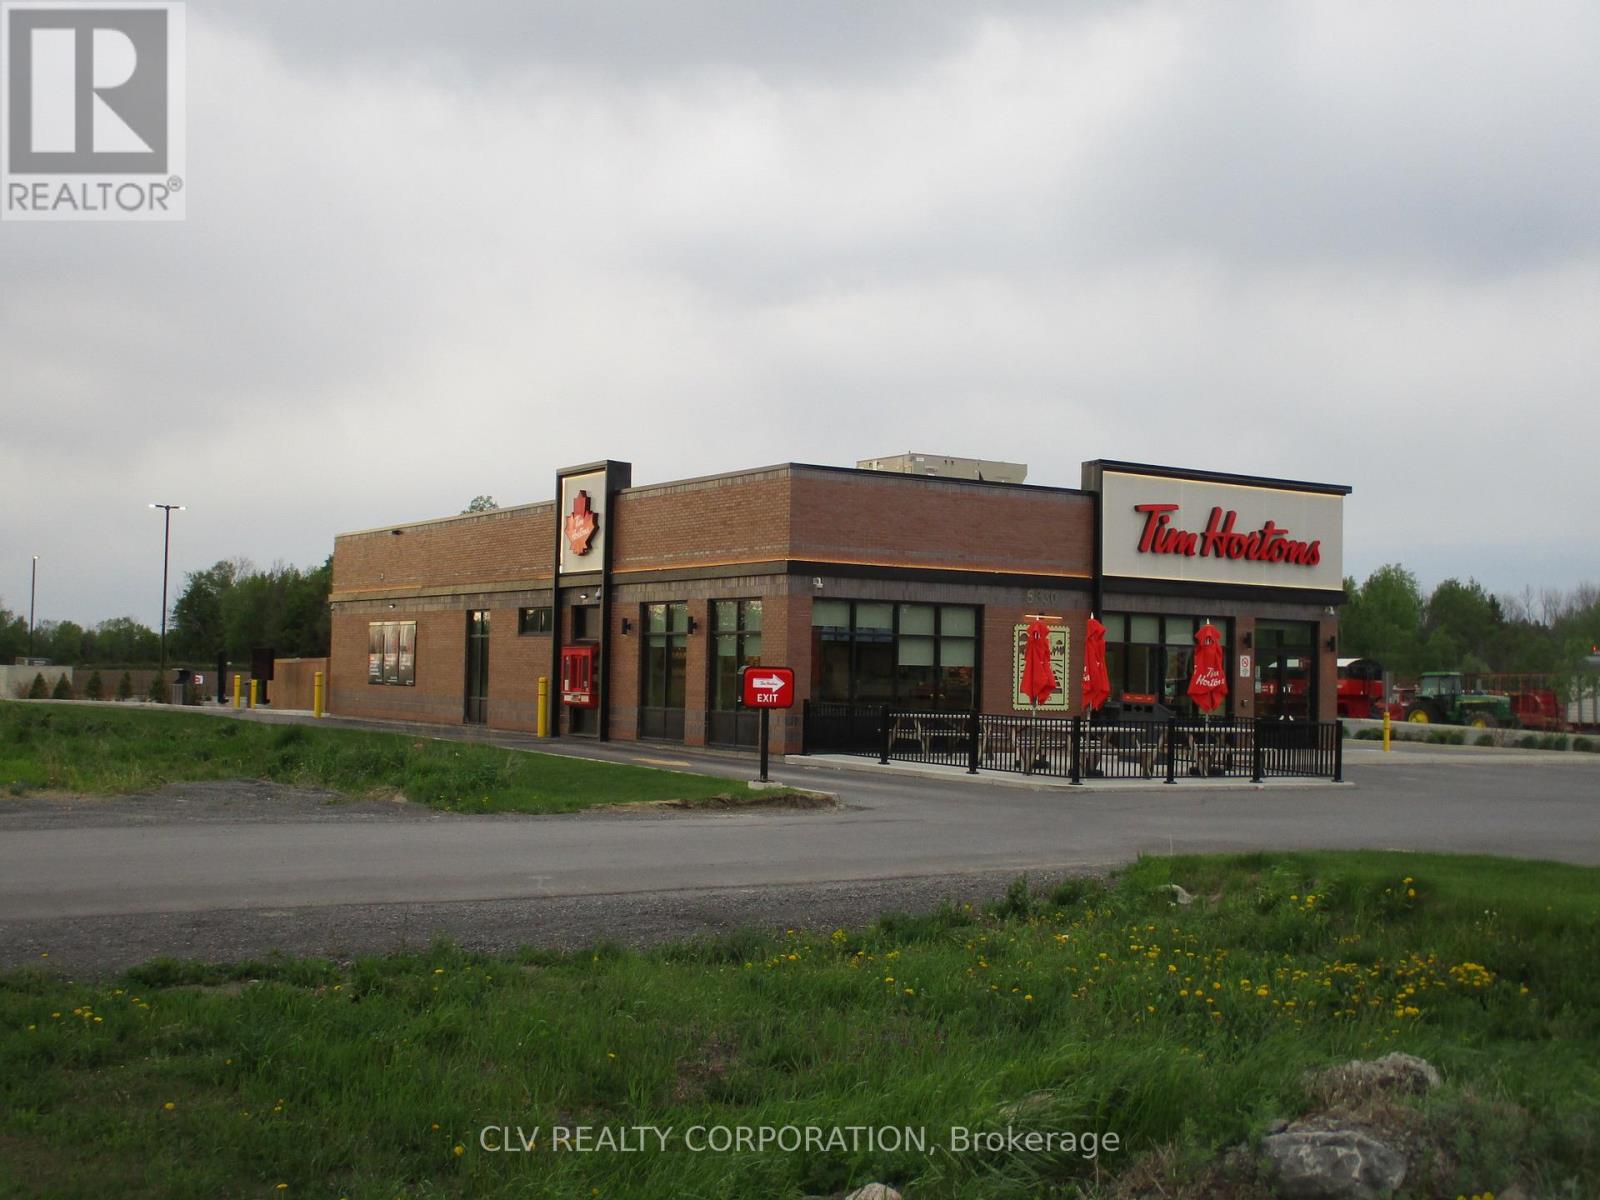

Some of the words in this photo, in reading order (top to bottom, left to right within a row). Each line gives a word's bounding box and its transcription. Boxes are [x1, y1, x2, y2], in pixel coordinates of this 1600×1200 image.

[1134, 503, 1198, 556] Tim
[1200, 506, 1321, 566] Hortons
[757, 693, 778, 703] EXIT
